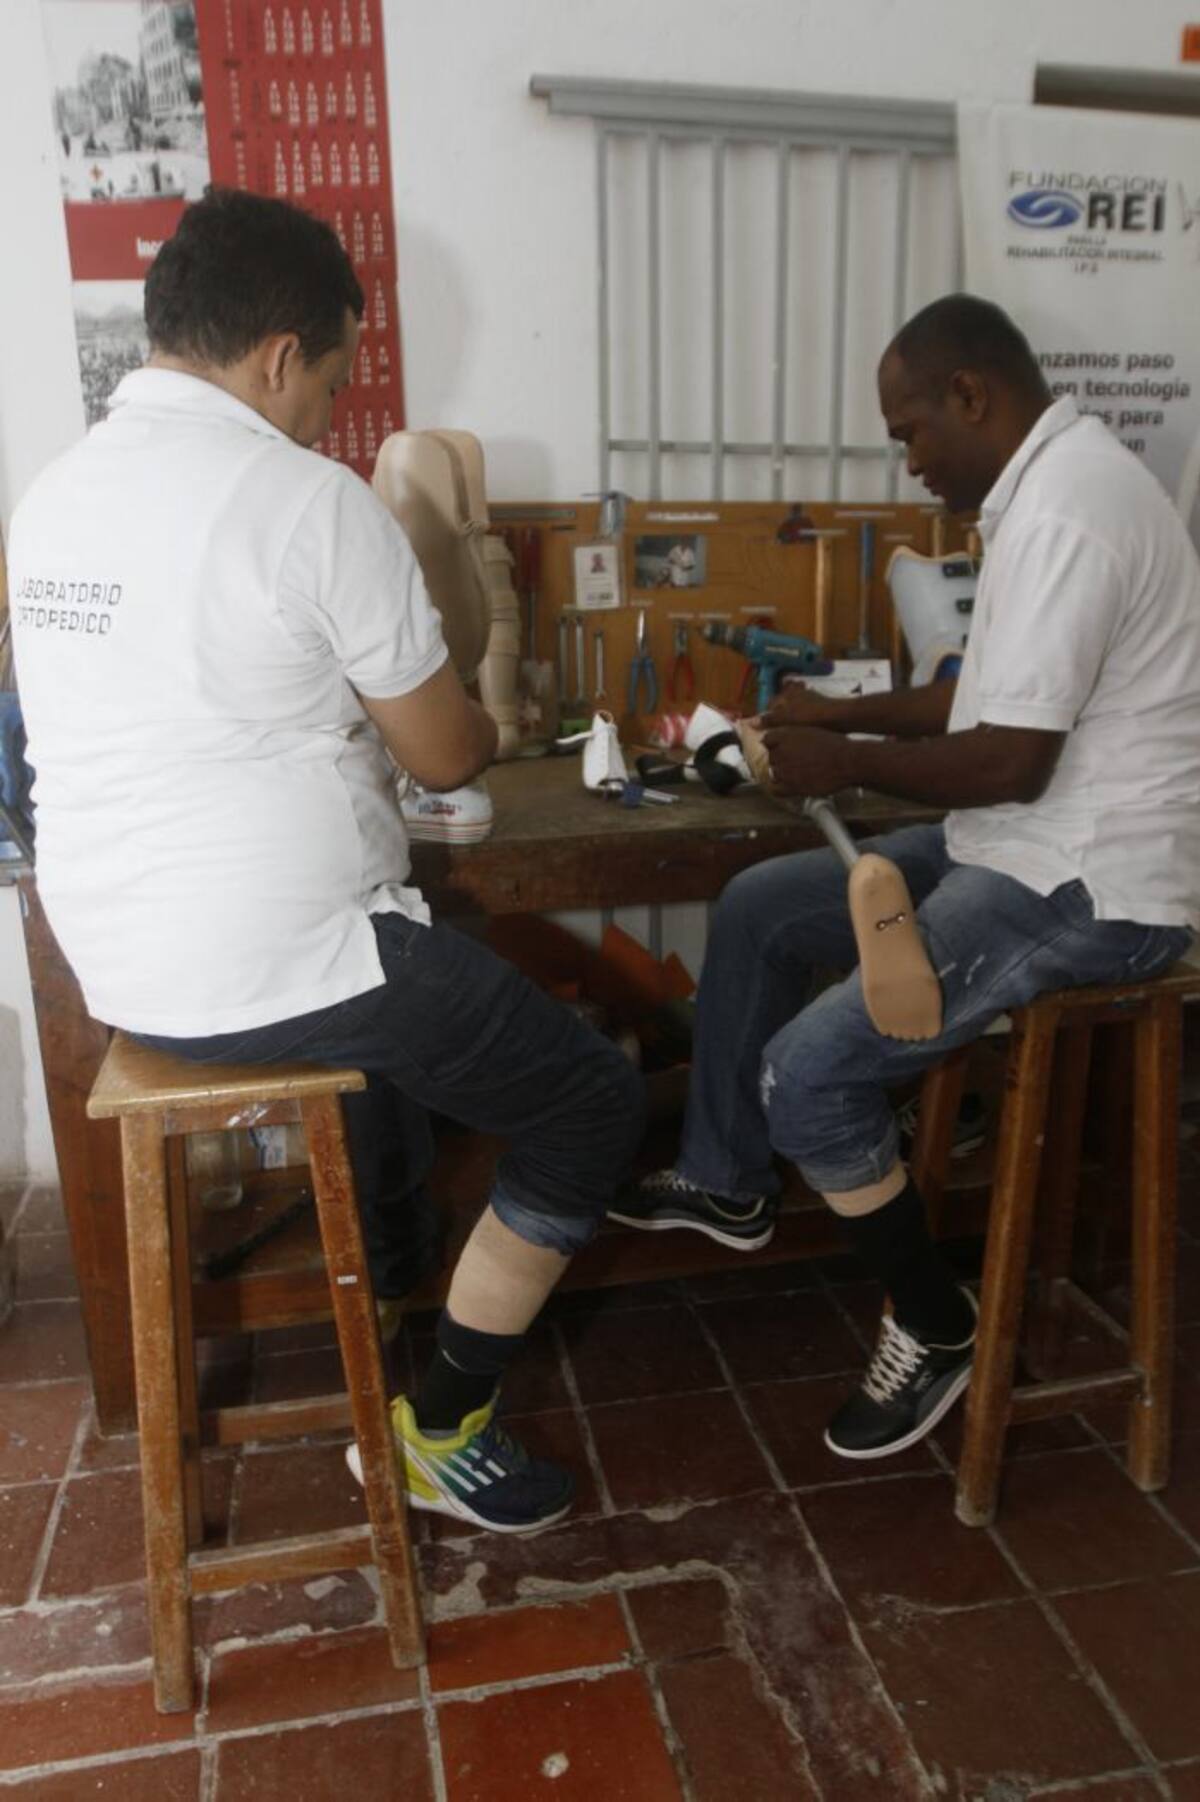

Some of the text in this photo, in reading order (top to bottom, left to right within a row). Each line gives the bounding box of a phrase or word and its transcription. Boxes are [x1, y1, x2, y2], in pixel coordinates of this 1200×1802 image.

[1087, 191, 1166, 231] REI
[1127, 353, 1175, 371] paso
[1119, 411, 1164, 428] para
